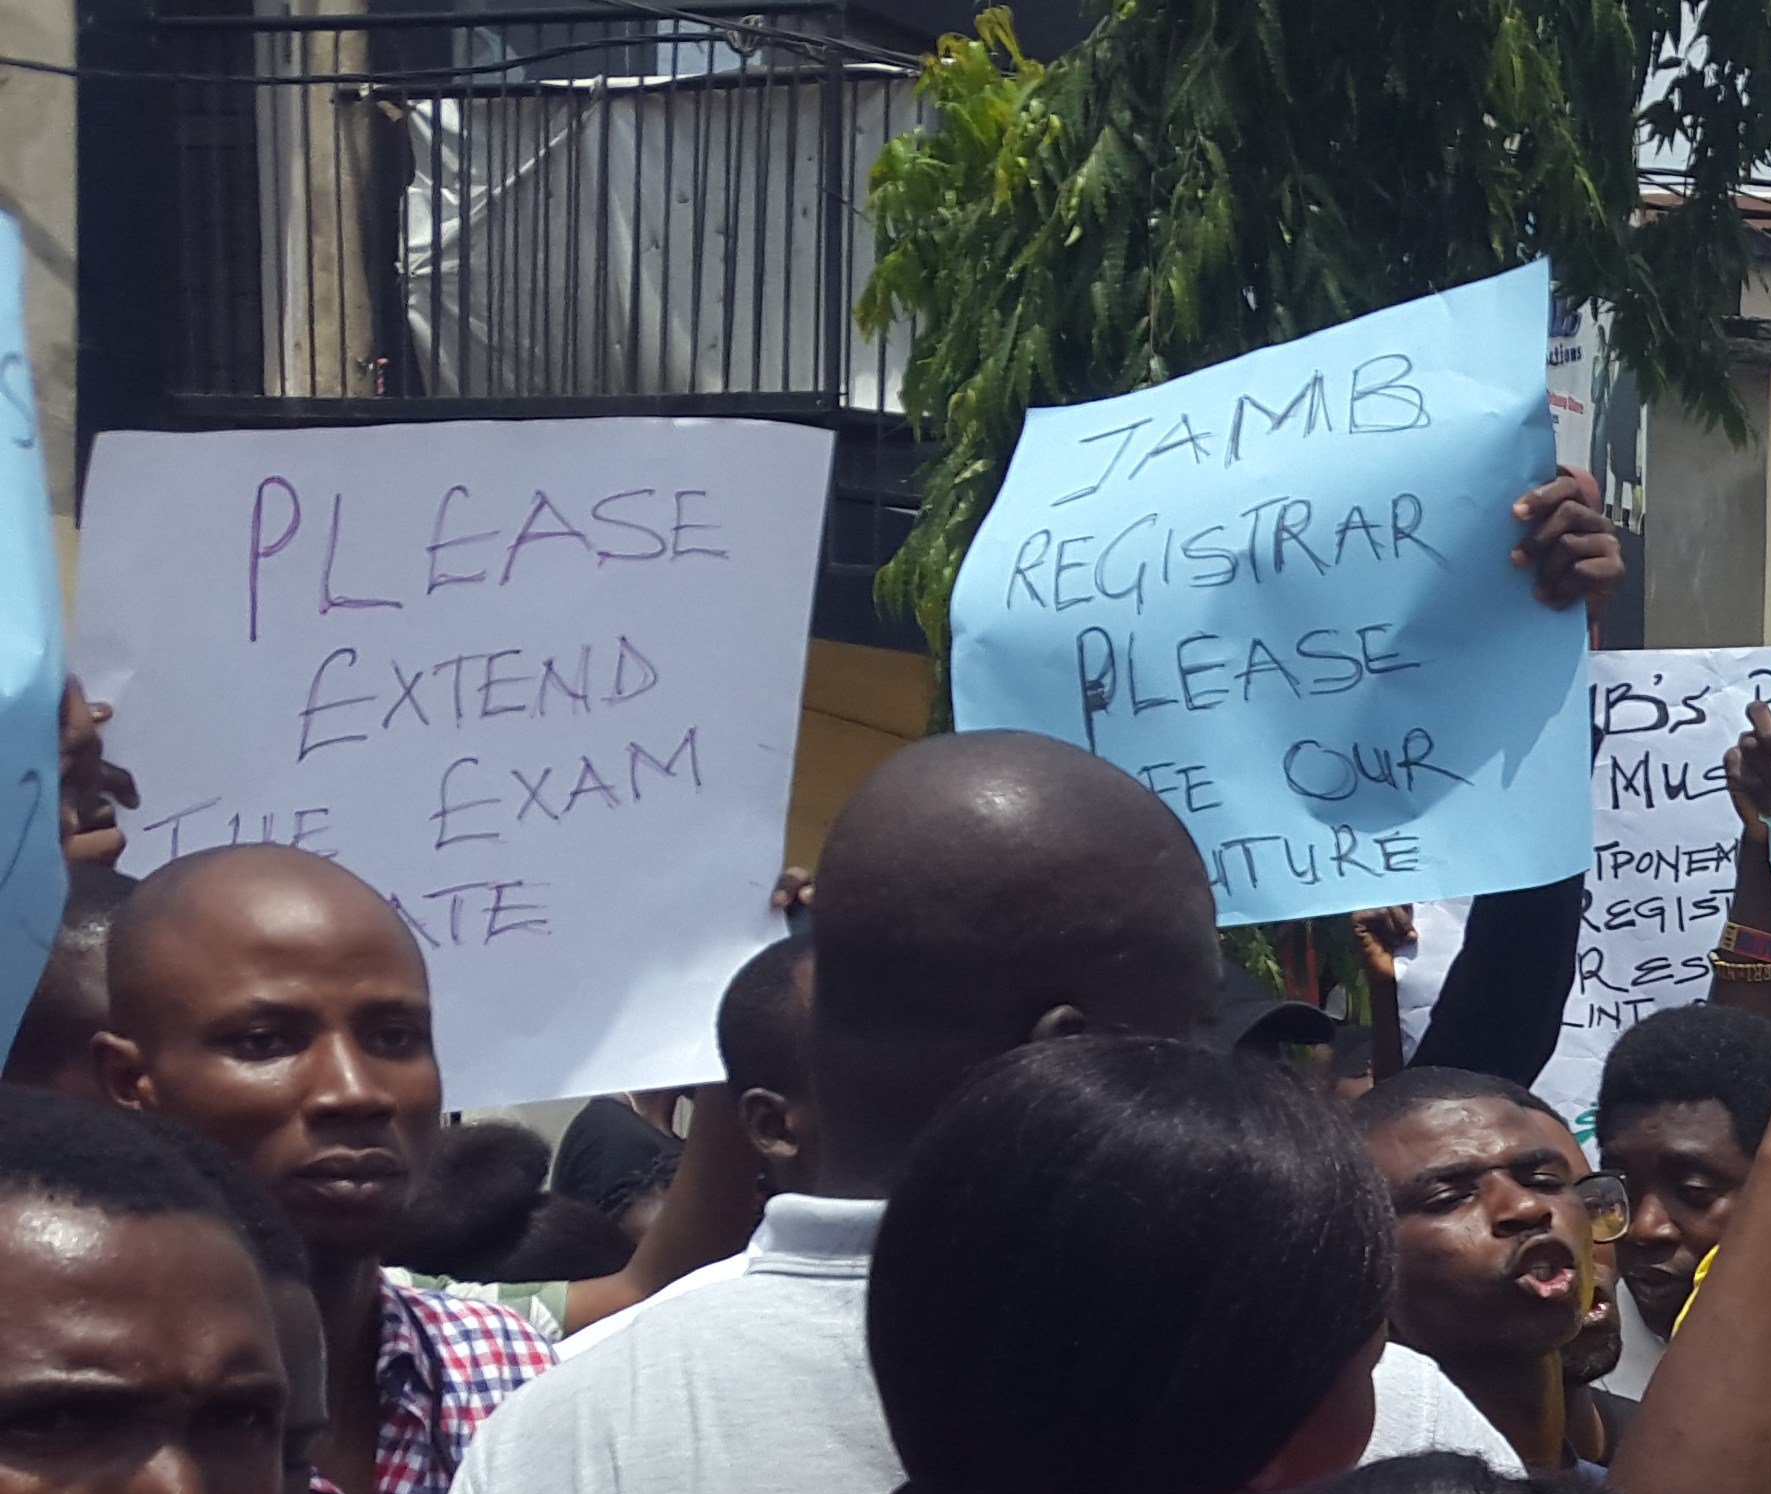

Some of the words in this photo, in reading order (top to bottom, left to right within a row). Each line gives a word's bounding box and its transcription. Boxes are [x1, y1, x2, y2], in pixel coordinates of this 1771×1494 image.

[1050, 351, 1433, 507] JAMB
[248, 475, 731, 643] PLEASE
[1005, 492, 1450, 613] REGISTRAR
[297, 635, 660, 763] EXTEND
[1078, 621, 1422, 756] PLEASE
[430, 726, 703, 851] EXAM
[1282, 726, 1475, 802] OUR
[1608, 749, 1731, 811] MUS
[387, 880, 552, 948] ATE
